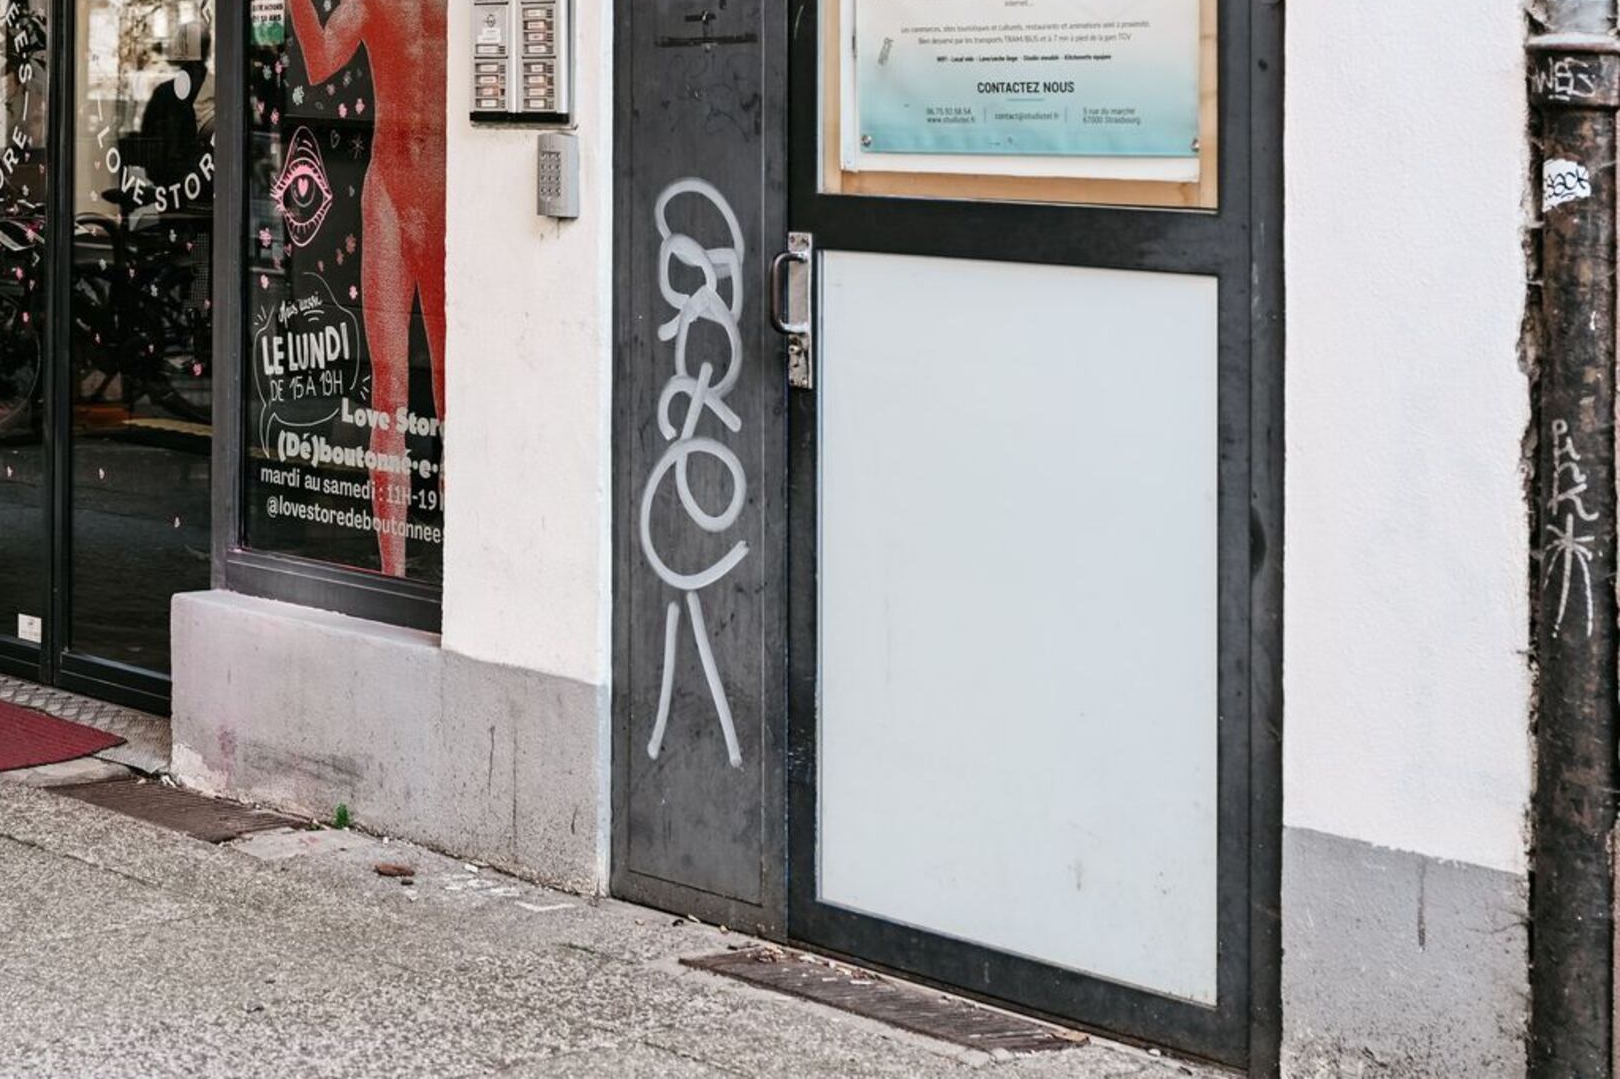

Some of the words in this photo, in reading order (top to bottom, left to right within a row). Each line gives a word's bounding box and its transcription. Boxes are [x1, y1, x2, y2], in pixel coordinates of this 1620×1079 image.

[977, 81, 1040, 93] CONTACTEZ
[1043, 81, 1075, 93] NOUS
[97, 126, 146, 205] LOVE
[155, 132, 216, 212] STOR
[261, 335, 284, 376] LE
[287, 322, 350, 372] LUNDI
[270, 379, 284, 402] DE
[289, 375, 304, 400] 15
[319, 369, 343, 396] 19H
[341, 397, 390, 431] Love
[260, 466, 300, 488] mardi
[304, 475, 320, 492] au
[323, 478, 376, 501] samedi
[267, 494, 445, 544] @lovestoredeboutonnee
